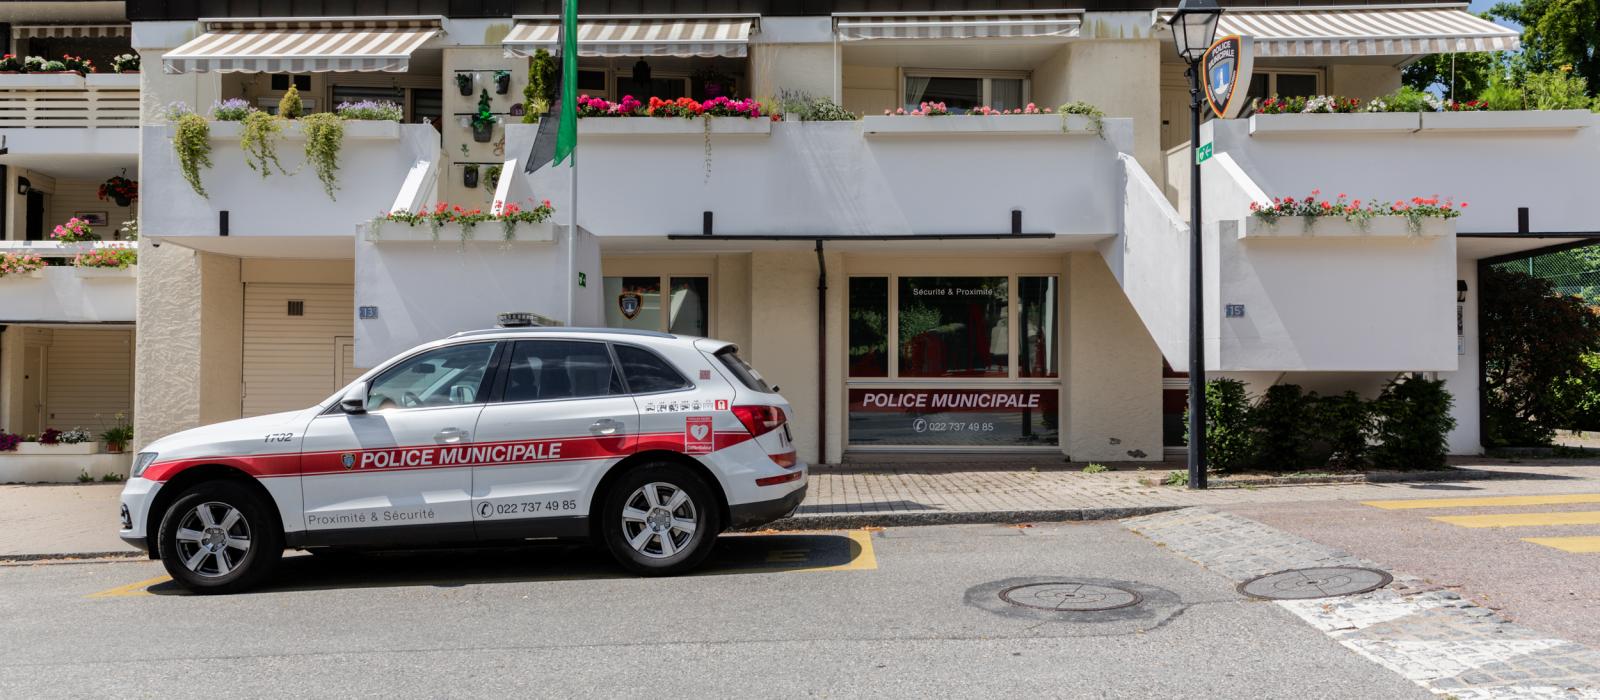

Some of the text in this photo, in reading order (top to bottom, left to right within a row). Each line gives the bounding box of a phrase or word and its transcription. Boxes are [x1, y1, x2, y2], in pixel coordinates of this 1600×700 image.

[1212, 41, 1230, 55] POLICE
[1208, 49, 1235, 69] MUNICIPALE
[913, 287, 993, 296] Sécurité & Proximité
[863, 393, 1040, 408] POLICE MUNICIPALE
[929, 422, 994, 432] 022 737 49 85
[264, 432, 294, 443] 1702
[360, 442, 562, 469] POLICE MUNICIPALE
[496, 499, 577, 514] 022 737 49 85
[308, 509, 435, 525] Proximité & Sécurité
